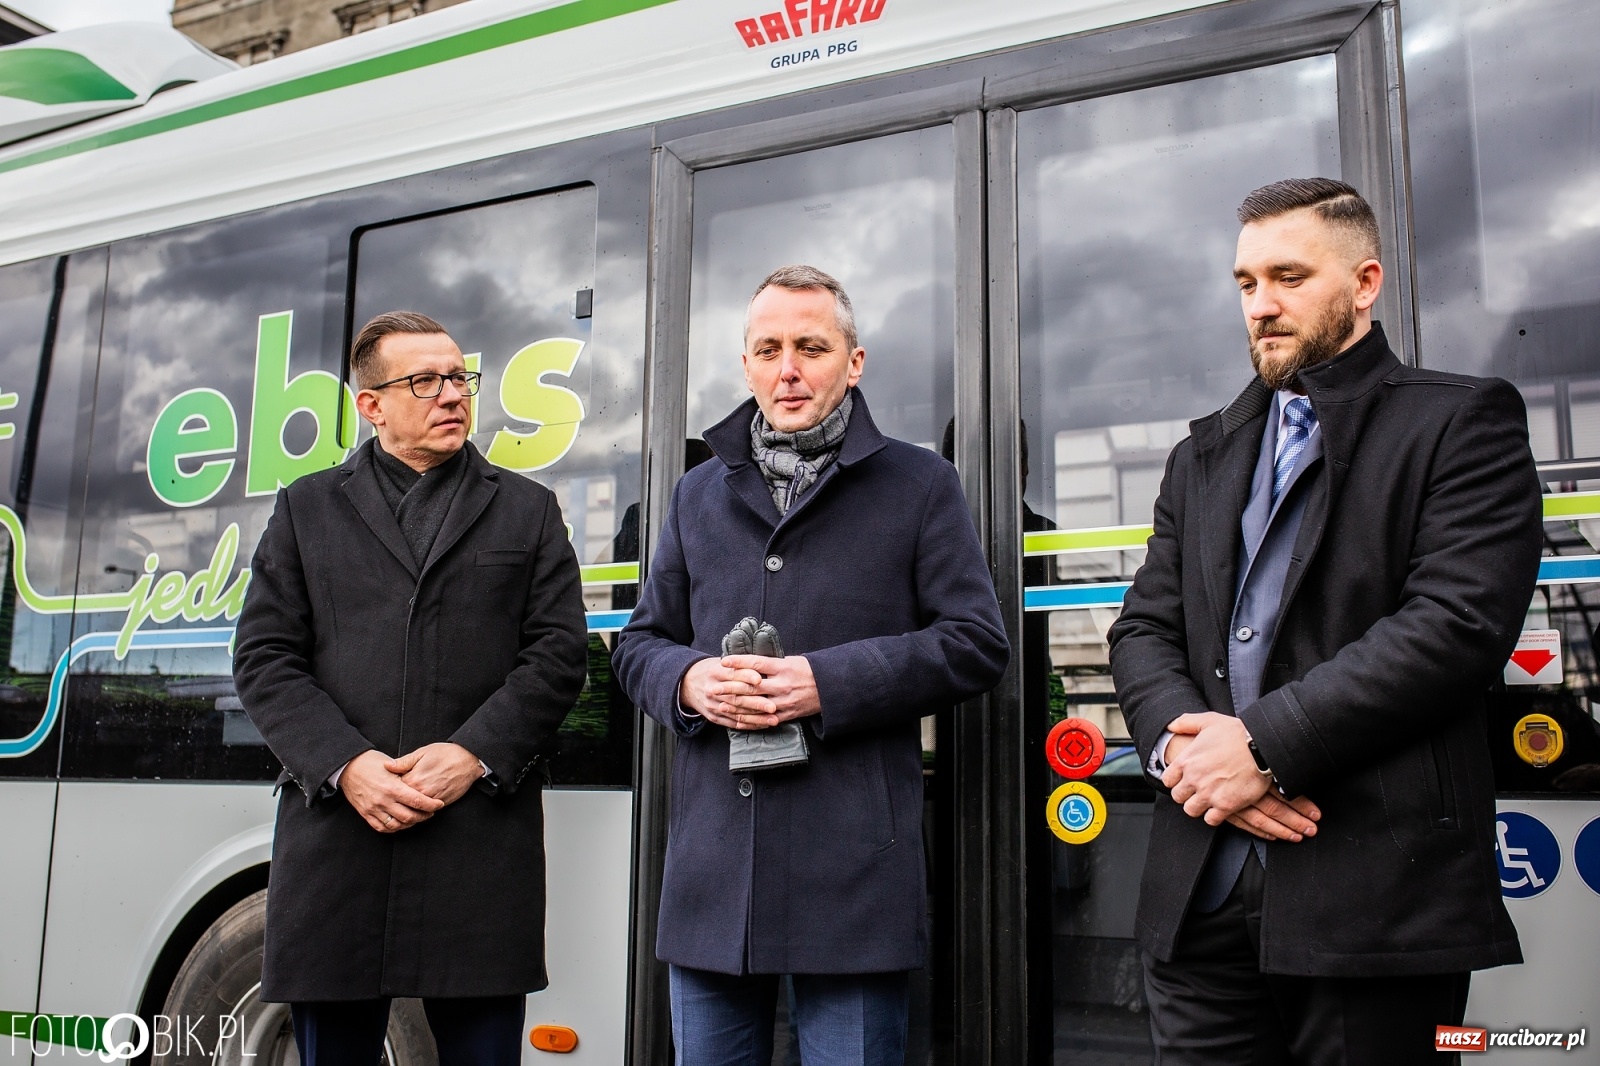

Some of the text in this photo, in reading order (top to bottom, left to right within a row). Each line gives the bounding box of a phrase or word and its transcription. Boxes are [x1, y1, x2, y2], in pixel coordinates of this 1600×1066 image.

[770, 40, 858, 69] GRUPA PBG
[146, 309, 587, 508] ebs
